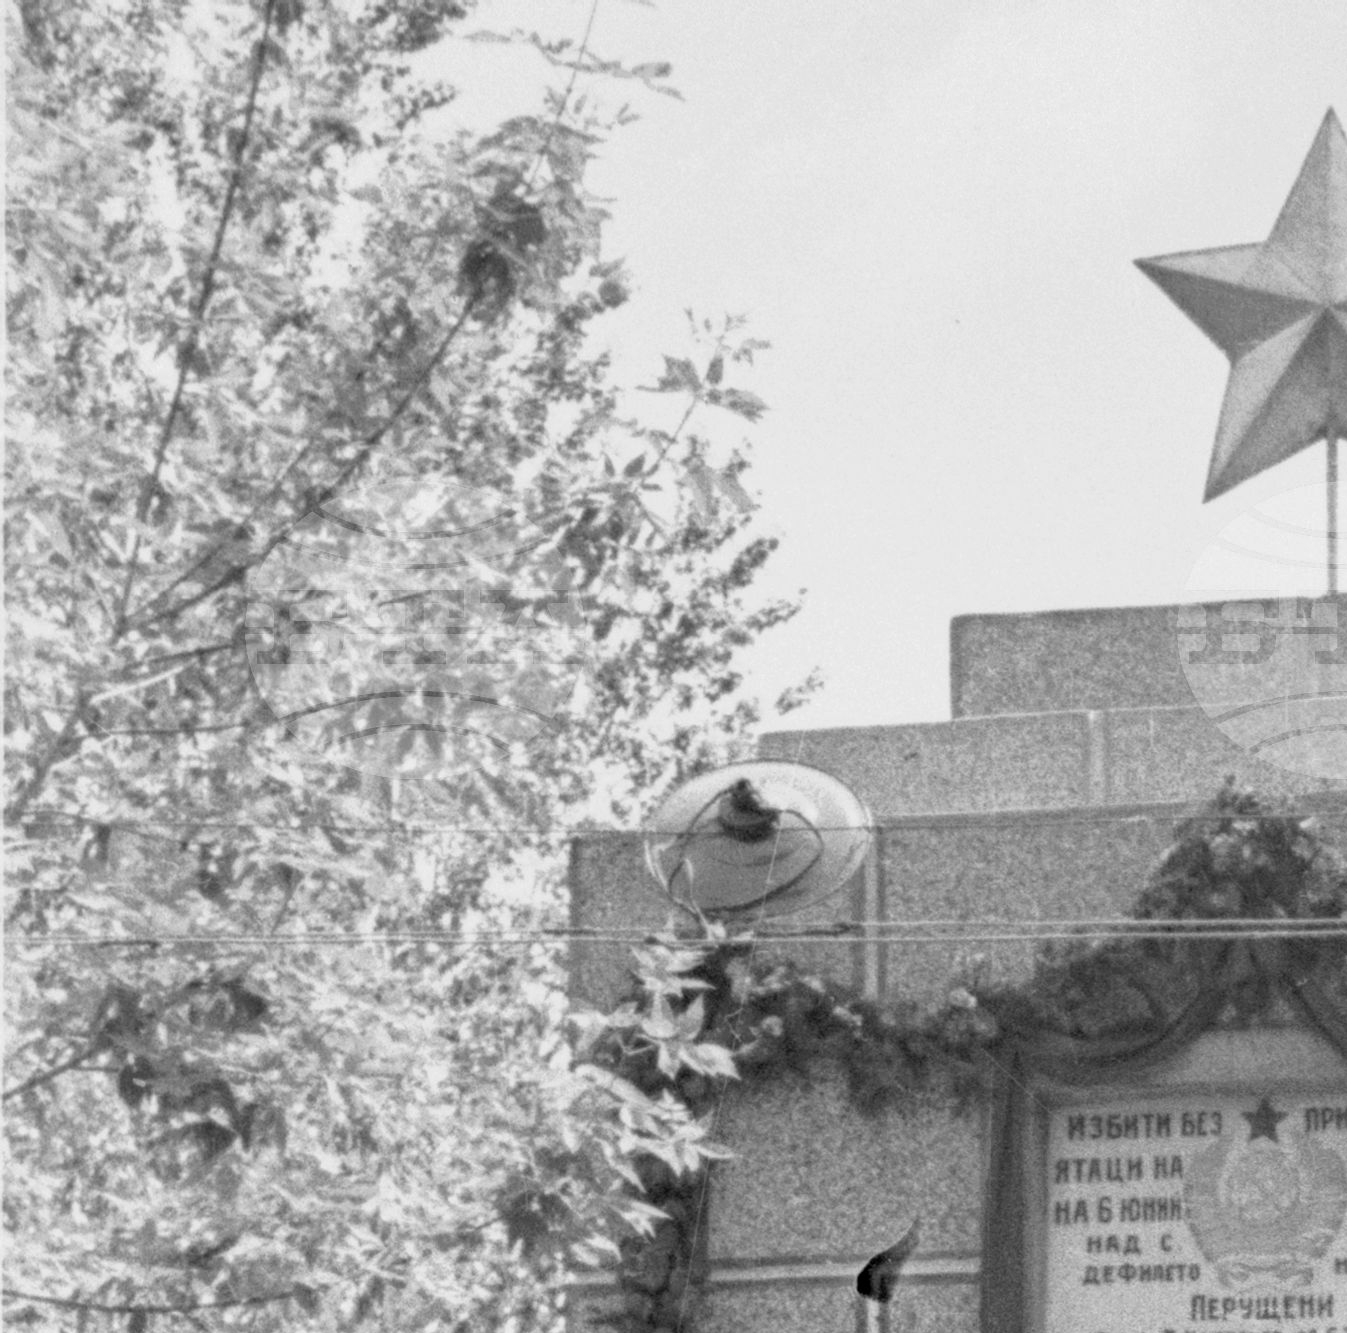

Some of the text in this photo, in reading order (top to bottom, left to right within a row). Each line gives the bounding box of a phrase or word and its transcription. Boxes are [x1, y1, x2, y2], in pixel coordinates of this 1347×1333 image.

[1068, 1112, 1171, 1140] ИЗБИТИ
[1181, 1111, 1223, 1136] БЕЗ
[1055, 1157, 1143, 1183] ЯТАЦИ
[1154, 1155, 1183, 1179] НА
[1055, 1200, 1088, 1224] НА
[1087, 1234, 1142, 1256] НАД
[1083, 1262, 1200, 1285] ДЕФИЛЕТО
[1191, 1294, 1333, 1321] ПЕРУЩЕНИ
